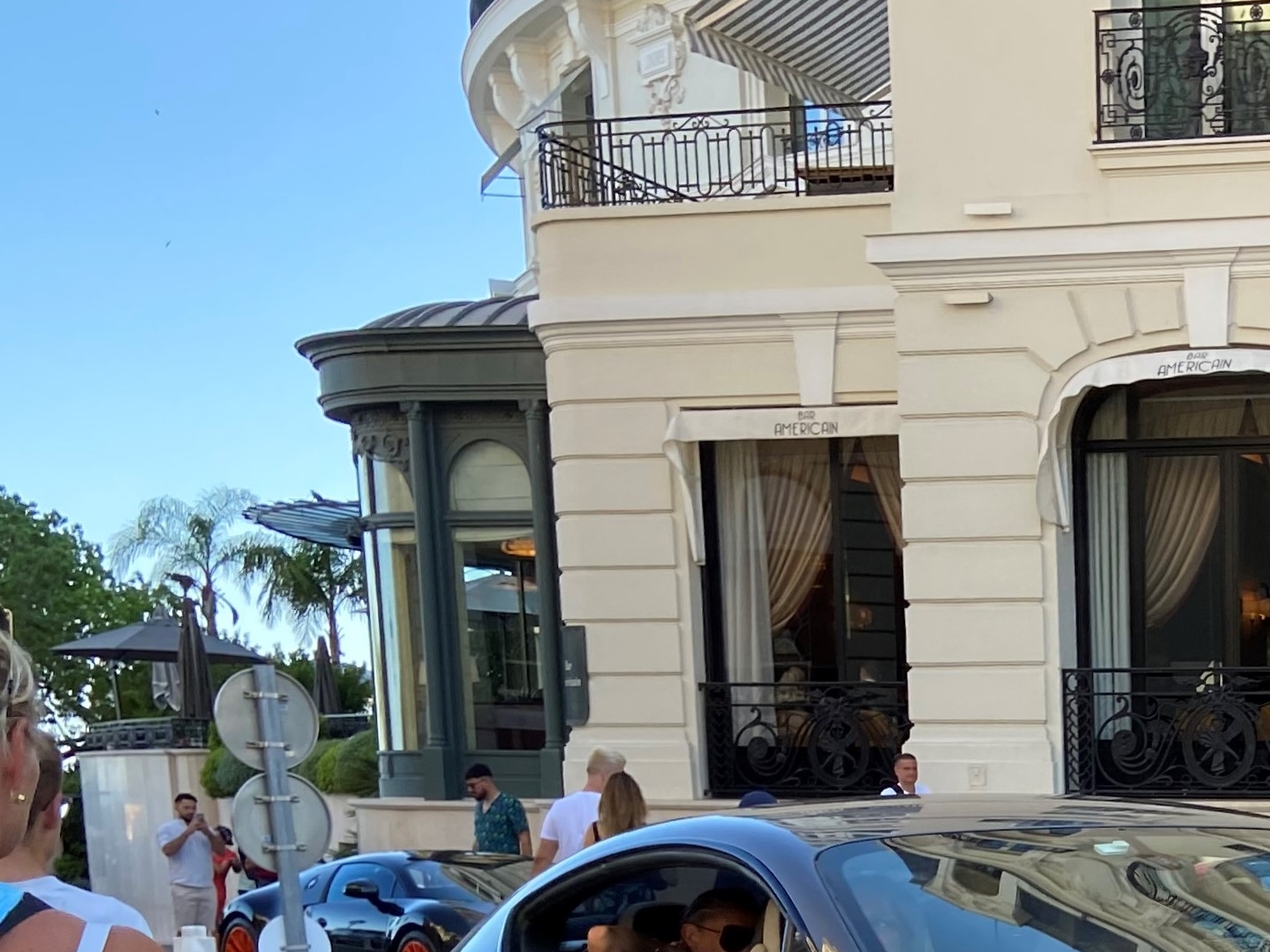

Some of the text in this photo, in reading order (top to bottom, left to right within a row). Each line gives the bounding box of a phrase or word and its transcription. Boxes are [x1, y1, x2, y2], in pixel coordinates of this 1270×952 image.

[1186, 352, 1209, 360] BAR
[1157, 358, 1233, 376] AMERICAIN
[797, 410, 816, 421] BAR
[774, 421, 839, 436] AMERICAIN
